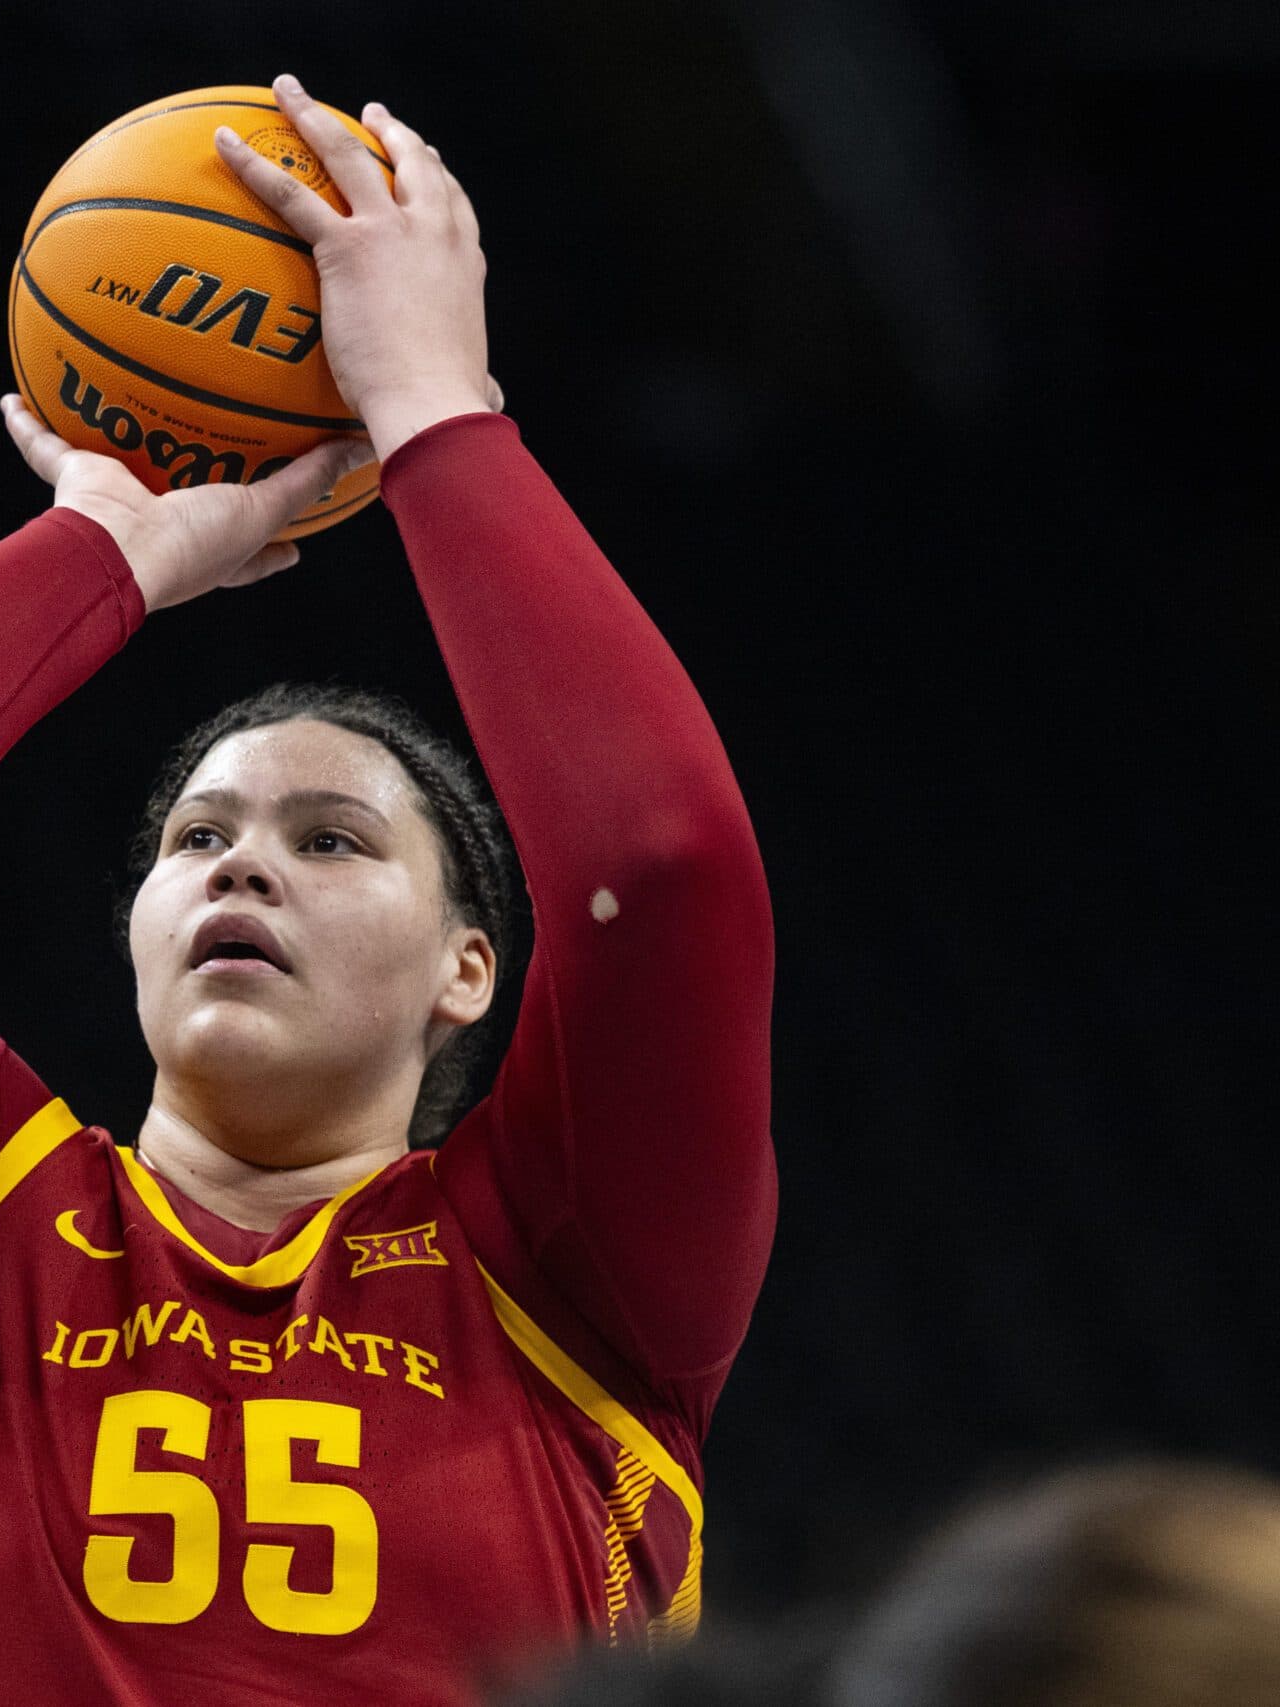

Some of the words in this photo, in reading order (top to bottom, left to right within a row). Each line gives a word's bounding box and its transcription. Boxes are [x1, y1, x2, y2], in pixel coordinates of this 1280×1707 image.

[86, 275, 141, 306] NXT
[138, 263, 321, 365] EVO
[125, 394, 159, 418] BALL
[162, 413, 205, 436] GAME
[208, 430, 269, 447] INDOOR
[343, 1220, 449, 1279] XII
[42, 1300, 217, 1369] IOWA
[229, 1314, 446, 1400] STATE
[82, 1389, 379, 1636] 55
